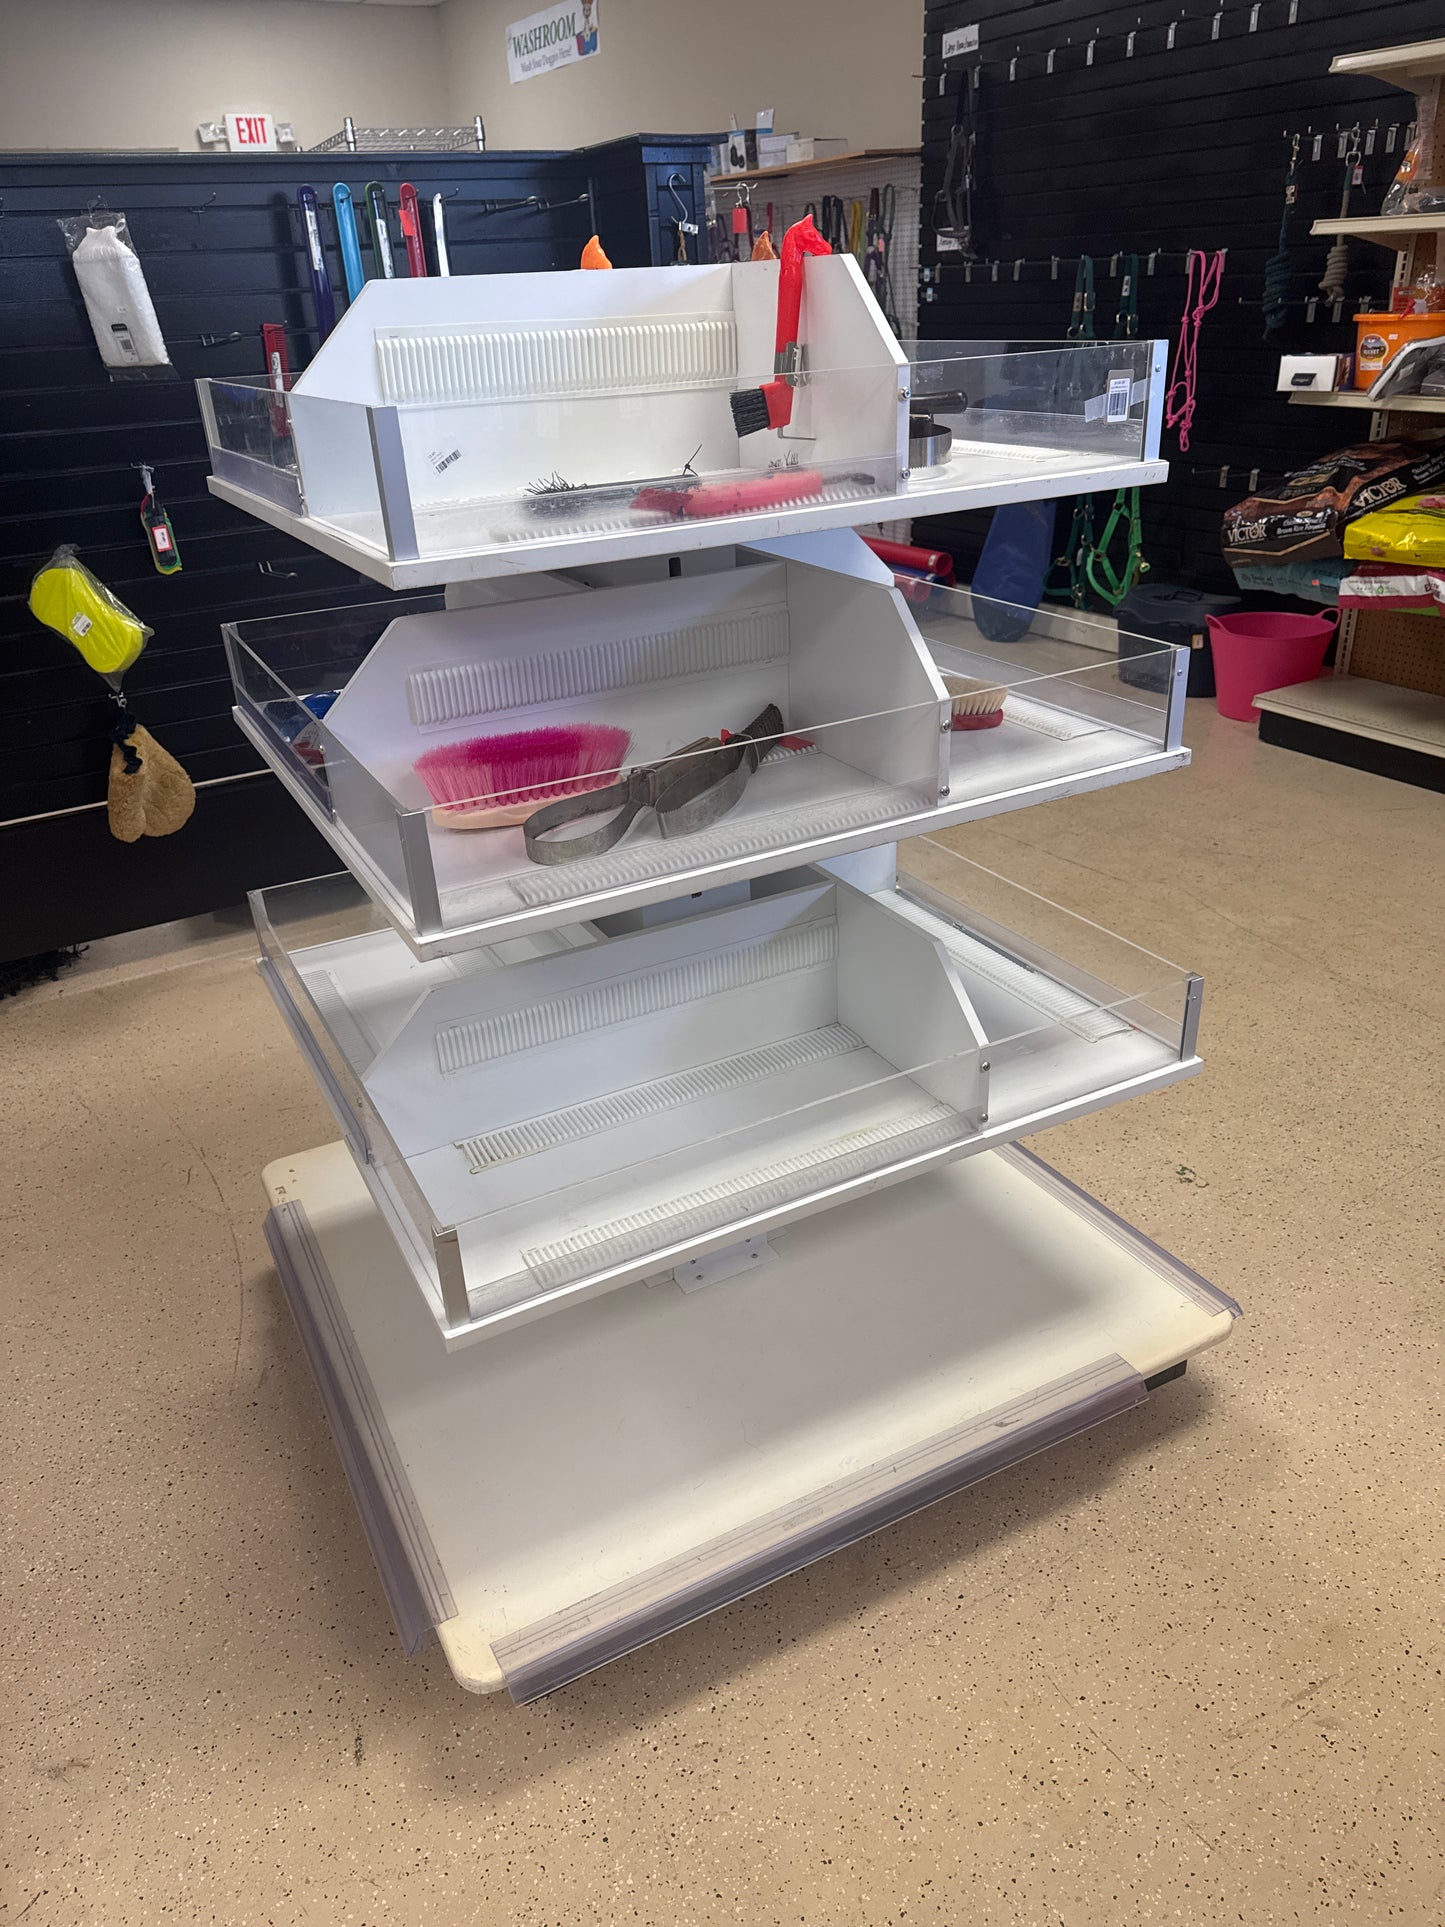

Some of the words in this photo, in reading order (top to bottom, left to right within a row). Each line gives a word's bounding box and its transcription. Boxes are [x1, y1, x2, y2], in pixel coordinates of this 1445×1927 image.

[512, 12, 577, 58] WASHROOM
[235, 117, 267, 144] EXIT
[1353, 477, 1407, 507] VICTOR
[1227, 524, 1267, 543] VICTOR
